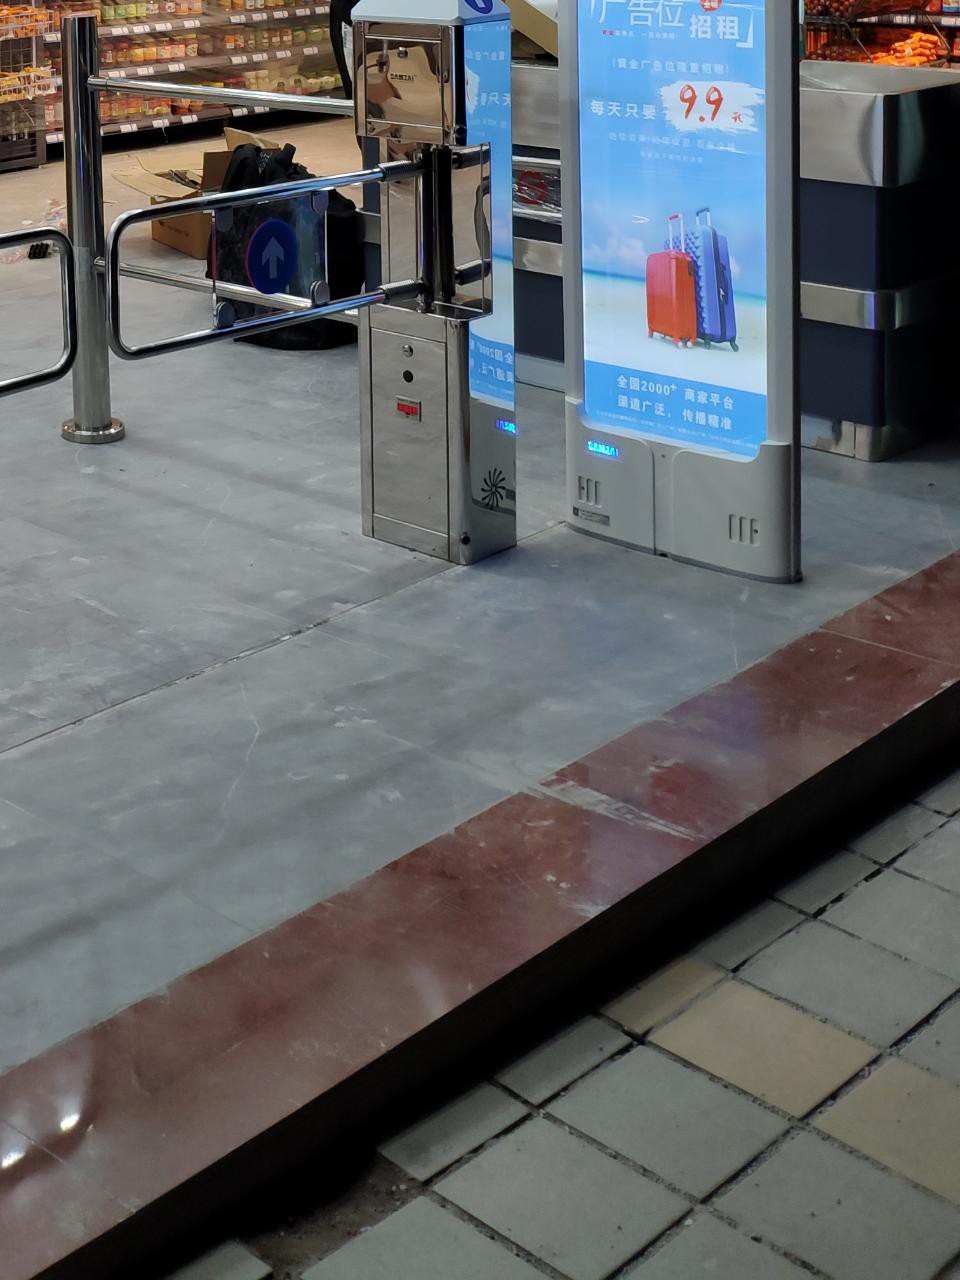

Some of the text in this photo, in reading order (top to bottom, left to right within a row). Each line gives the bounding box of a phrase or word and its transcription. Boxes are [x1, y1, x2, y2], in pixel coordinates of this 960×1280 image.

[690, 15, 740, 40] 招租
[590, 99, 656, 120] 每天只要
[679, 84, 724, 123] 9.9
[683, 388, 735, 410] 商家平台
[682, 408, 732, 430] 传播精准
